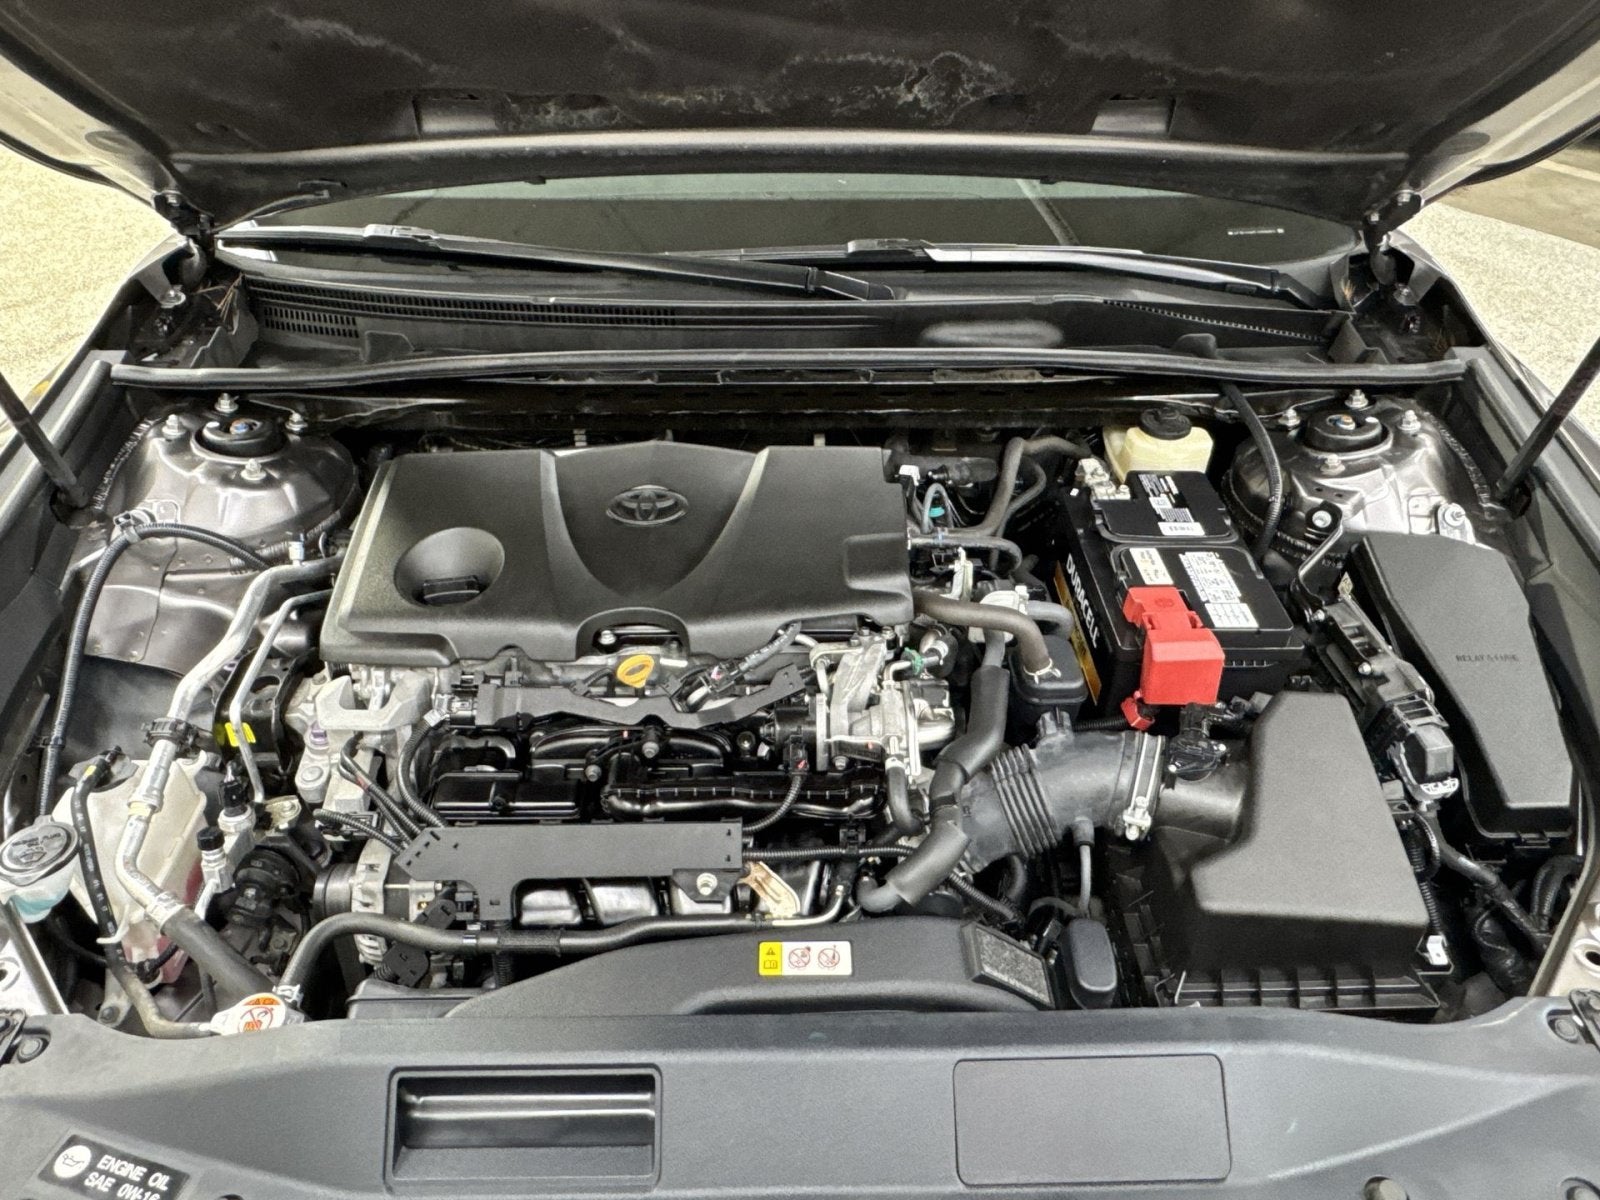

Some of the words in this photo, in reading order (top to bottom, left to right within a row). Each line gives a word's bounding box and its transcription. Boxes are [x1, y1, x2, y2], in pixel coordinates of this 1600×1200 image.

[1066, 553, 1099, 648] DURACELL
[84, 1171, 116, 1193] SAE
[96, 1154, 148, 1182] ENGINE
[148, 1172, 170, 1191] OIL
